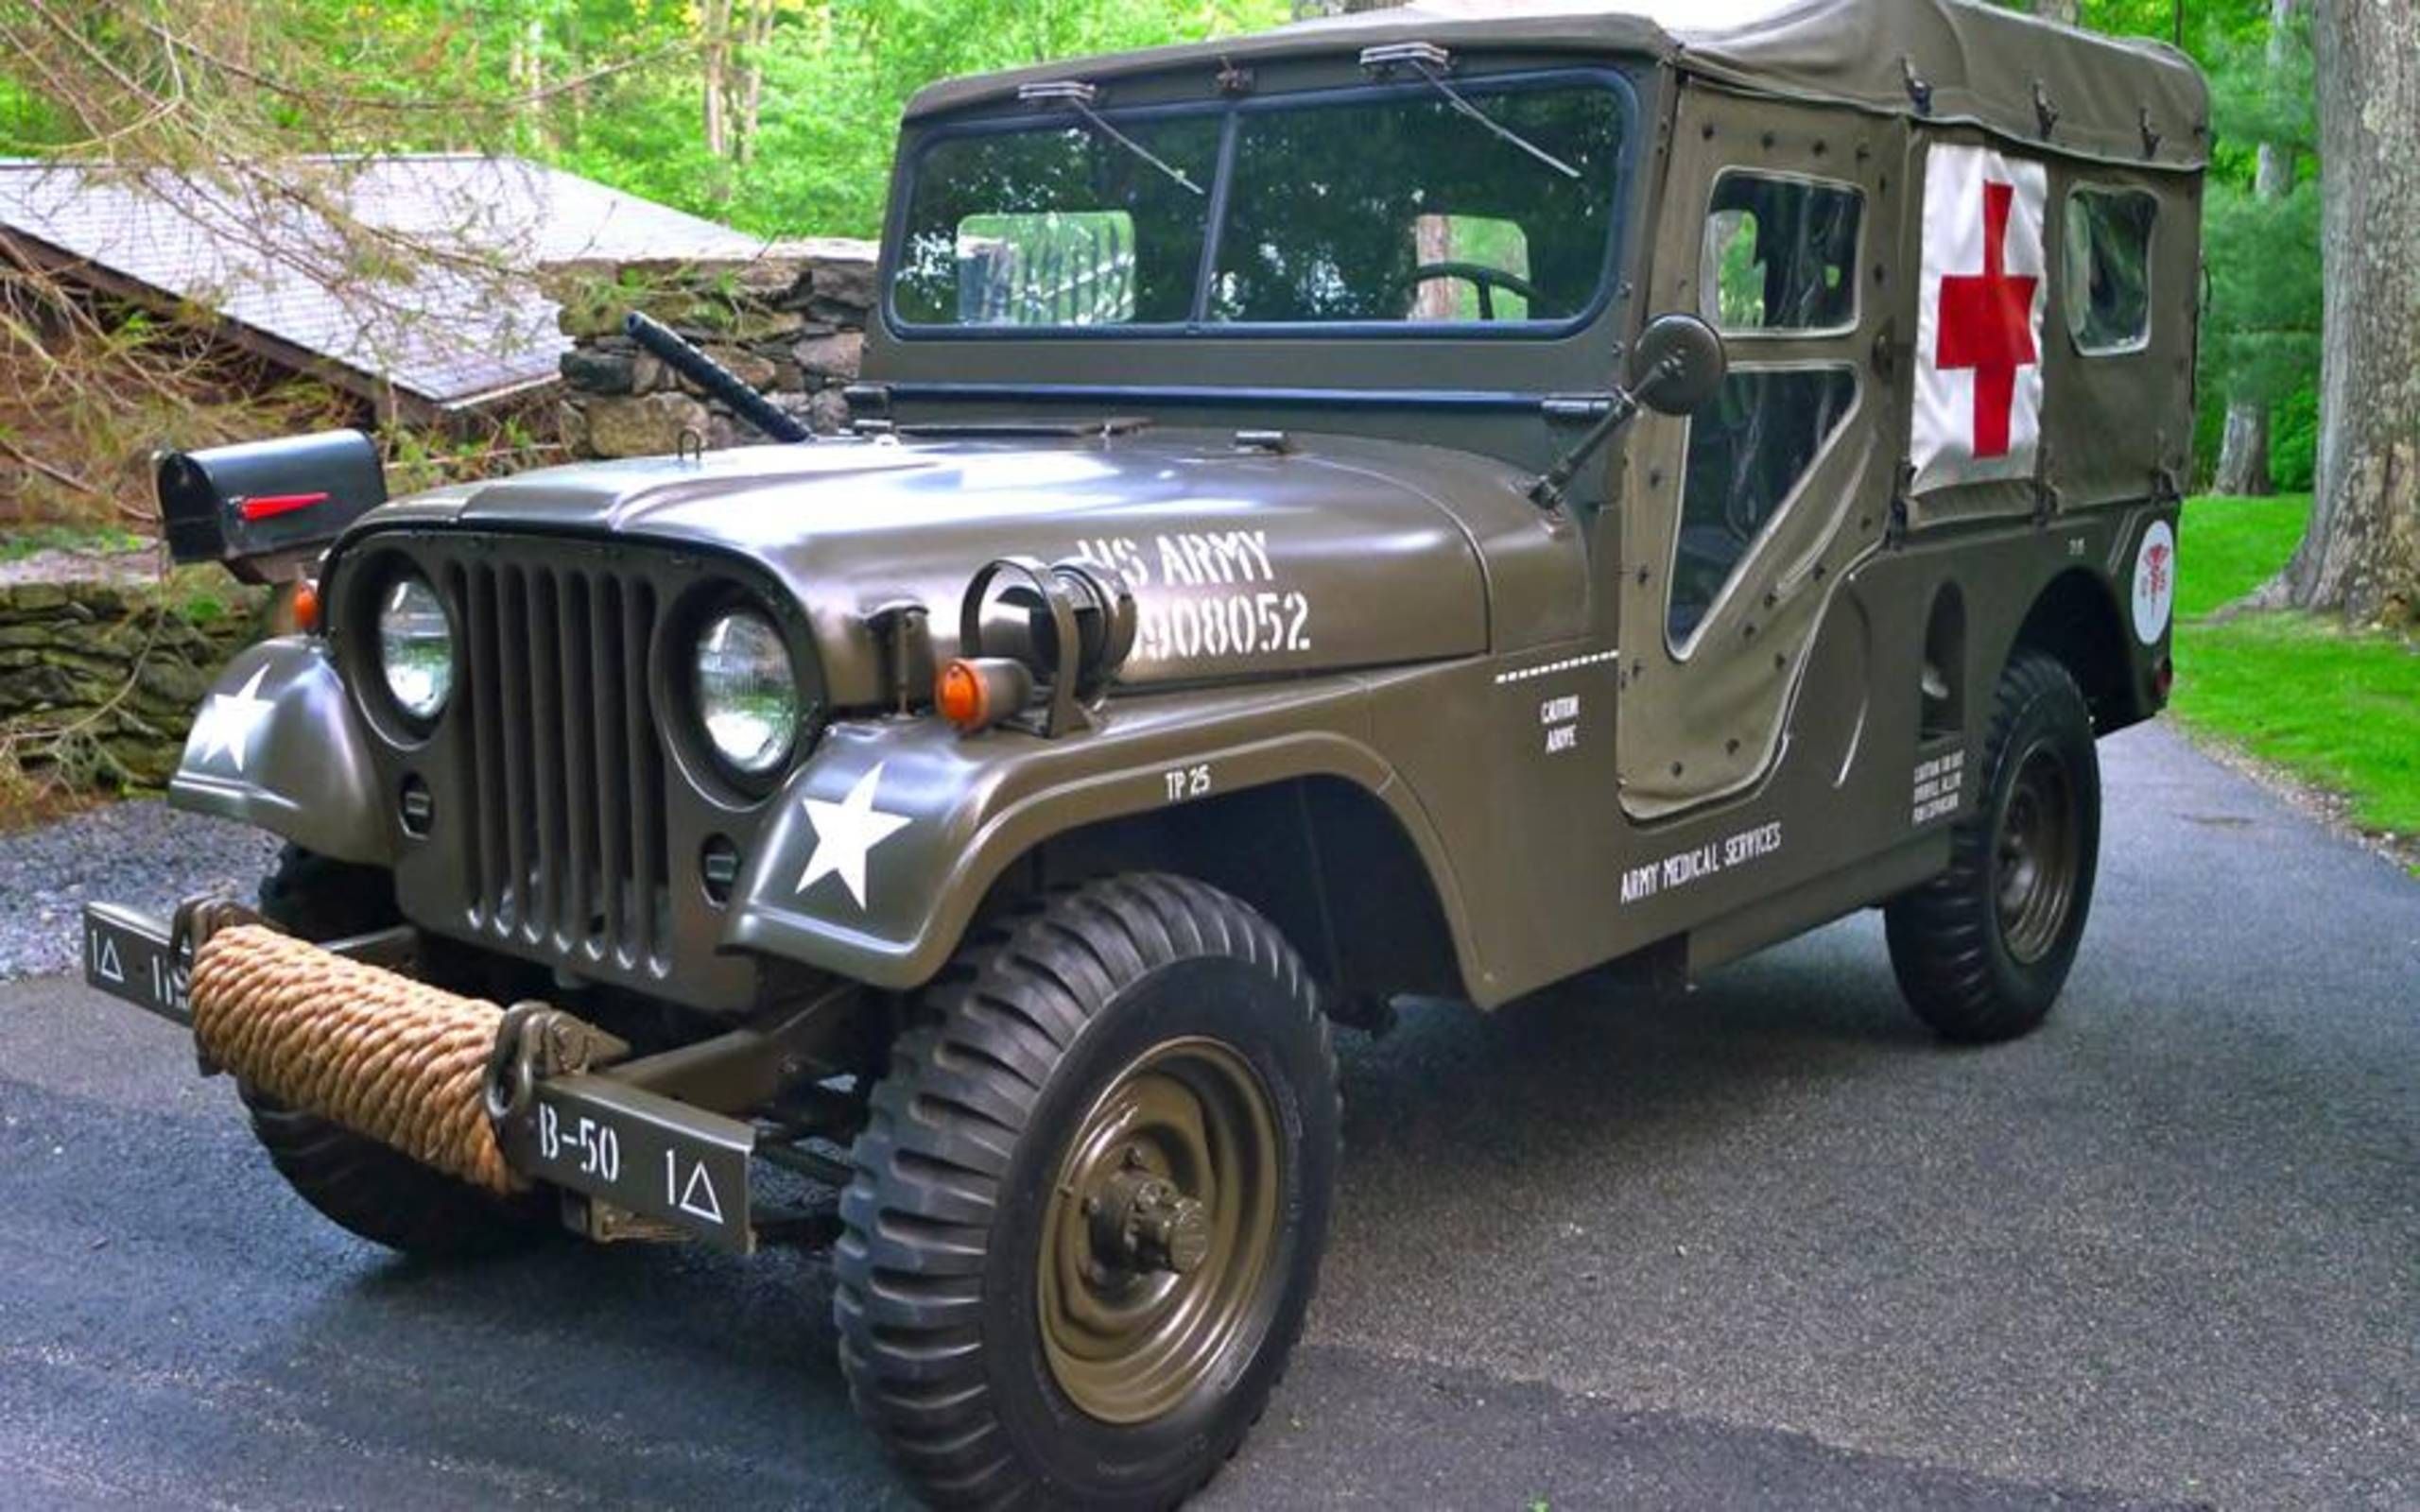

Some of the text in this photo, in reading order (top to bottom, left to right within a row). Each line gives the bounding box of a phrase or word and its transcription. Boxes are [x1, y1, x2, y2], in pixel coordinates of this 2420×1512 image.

[1156, 530, 1273, 587] ARMY
[1165, 763, 1211, 801] TP 25
[1620, 820, 1782, 904] ARMY MEDICAL SERVICES
[539, 1102, 619, 1182] B-50
